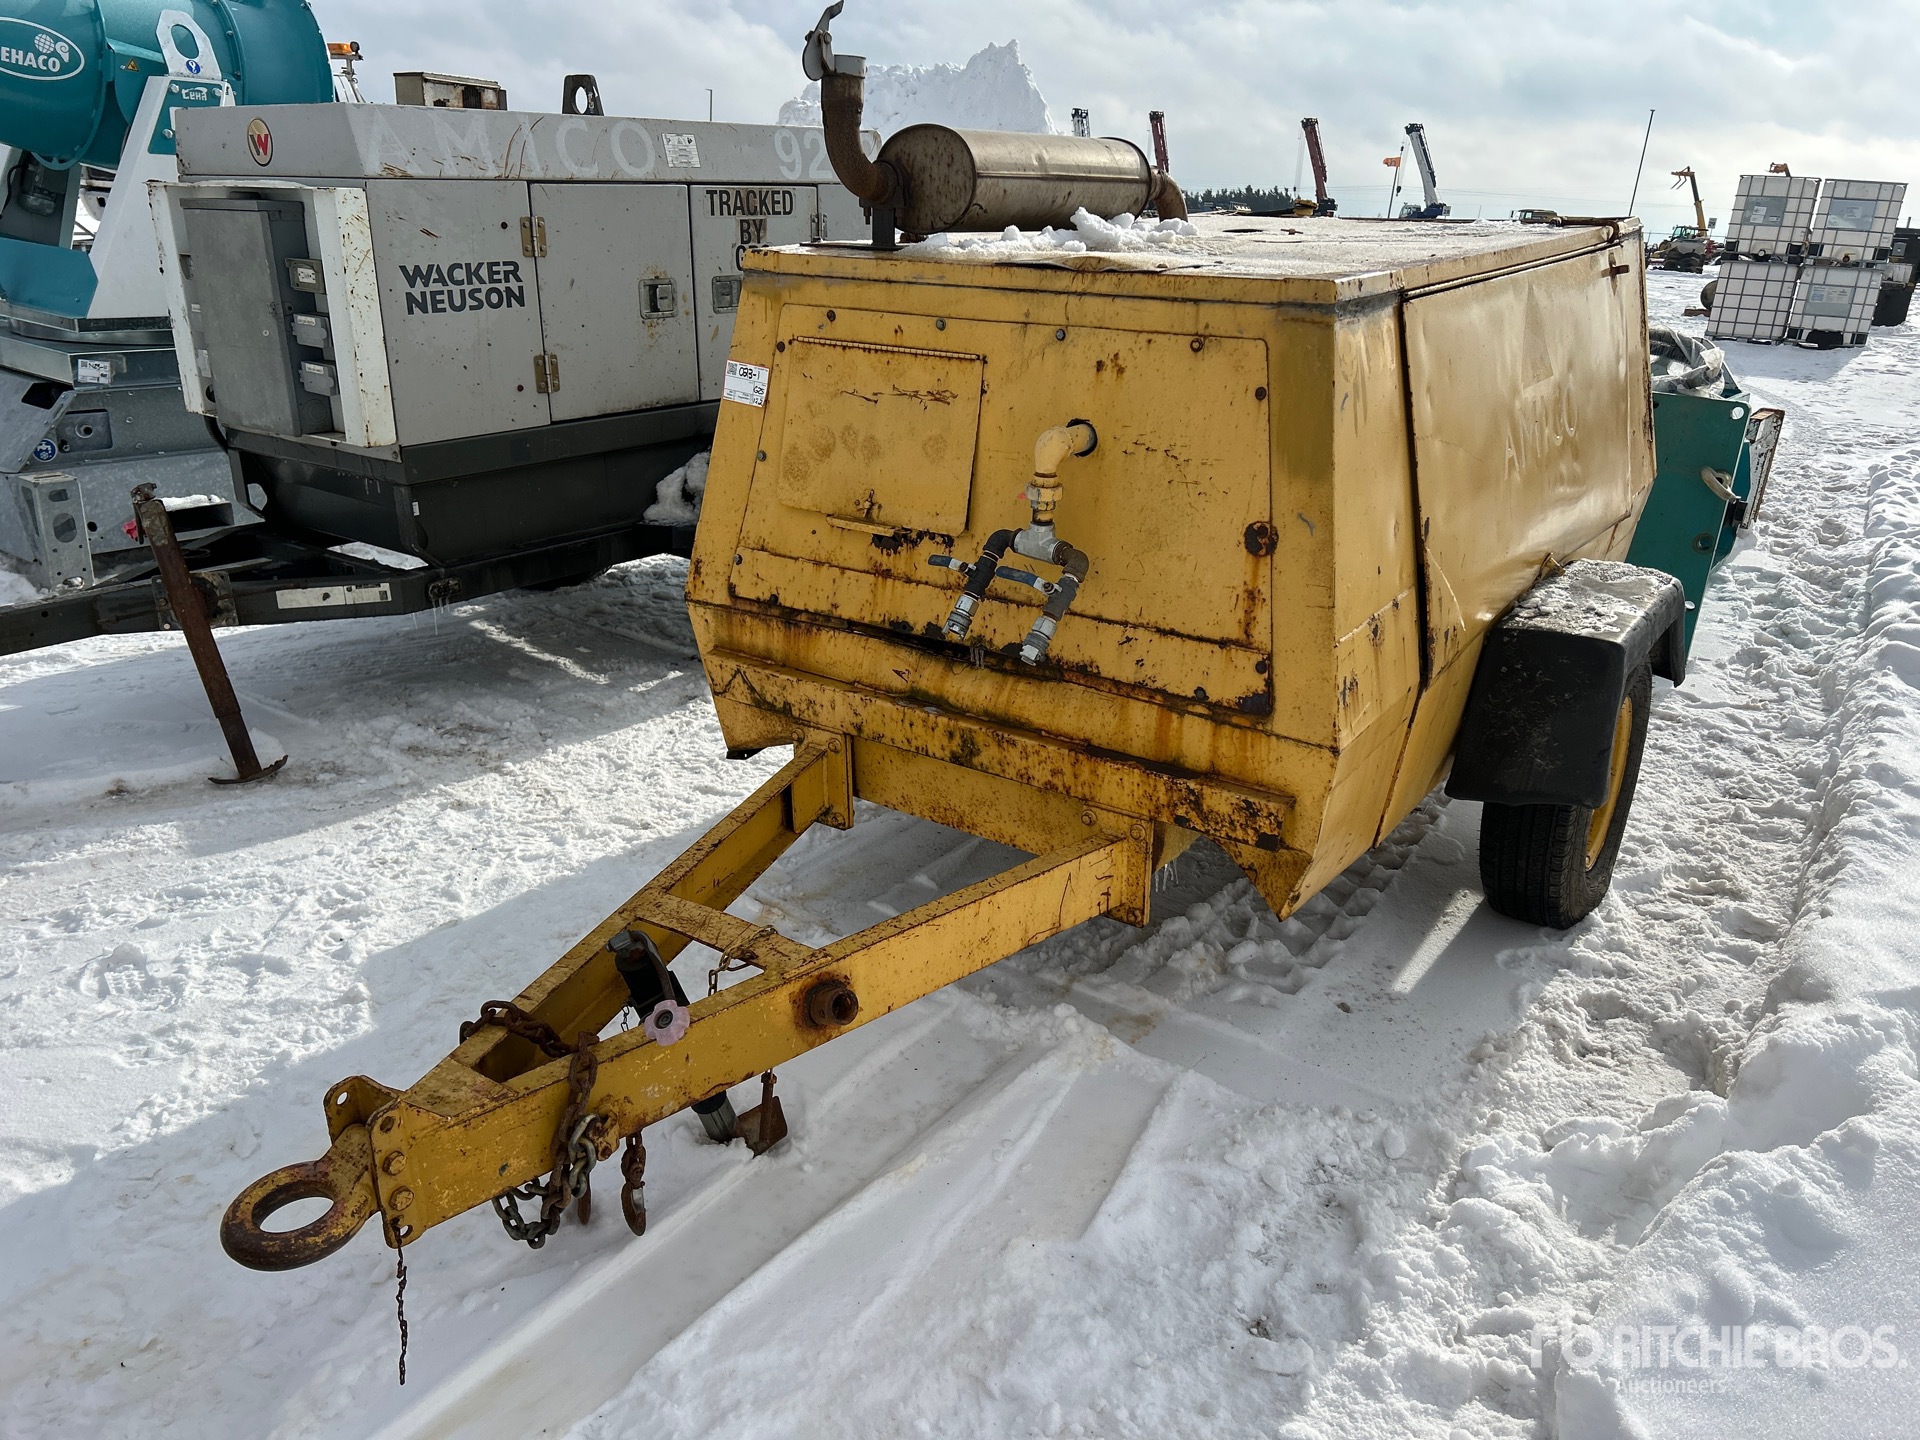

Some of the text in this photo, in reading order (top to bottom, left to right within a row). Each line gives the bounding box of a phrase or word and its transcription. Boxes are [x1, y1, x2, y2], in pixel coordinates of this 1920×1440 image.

[0, 46, 60, 73] EHACO
[706, 189, 793, 216] TRACKED
[740, 219, 764, 244] BY
[399, 261, 523, 288] WACKER
[405, 285, 525, 315] NEUSON
